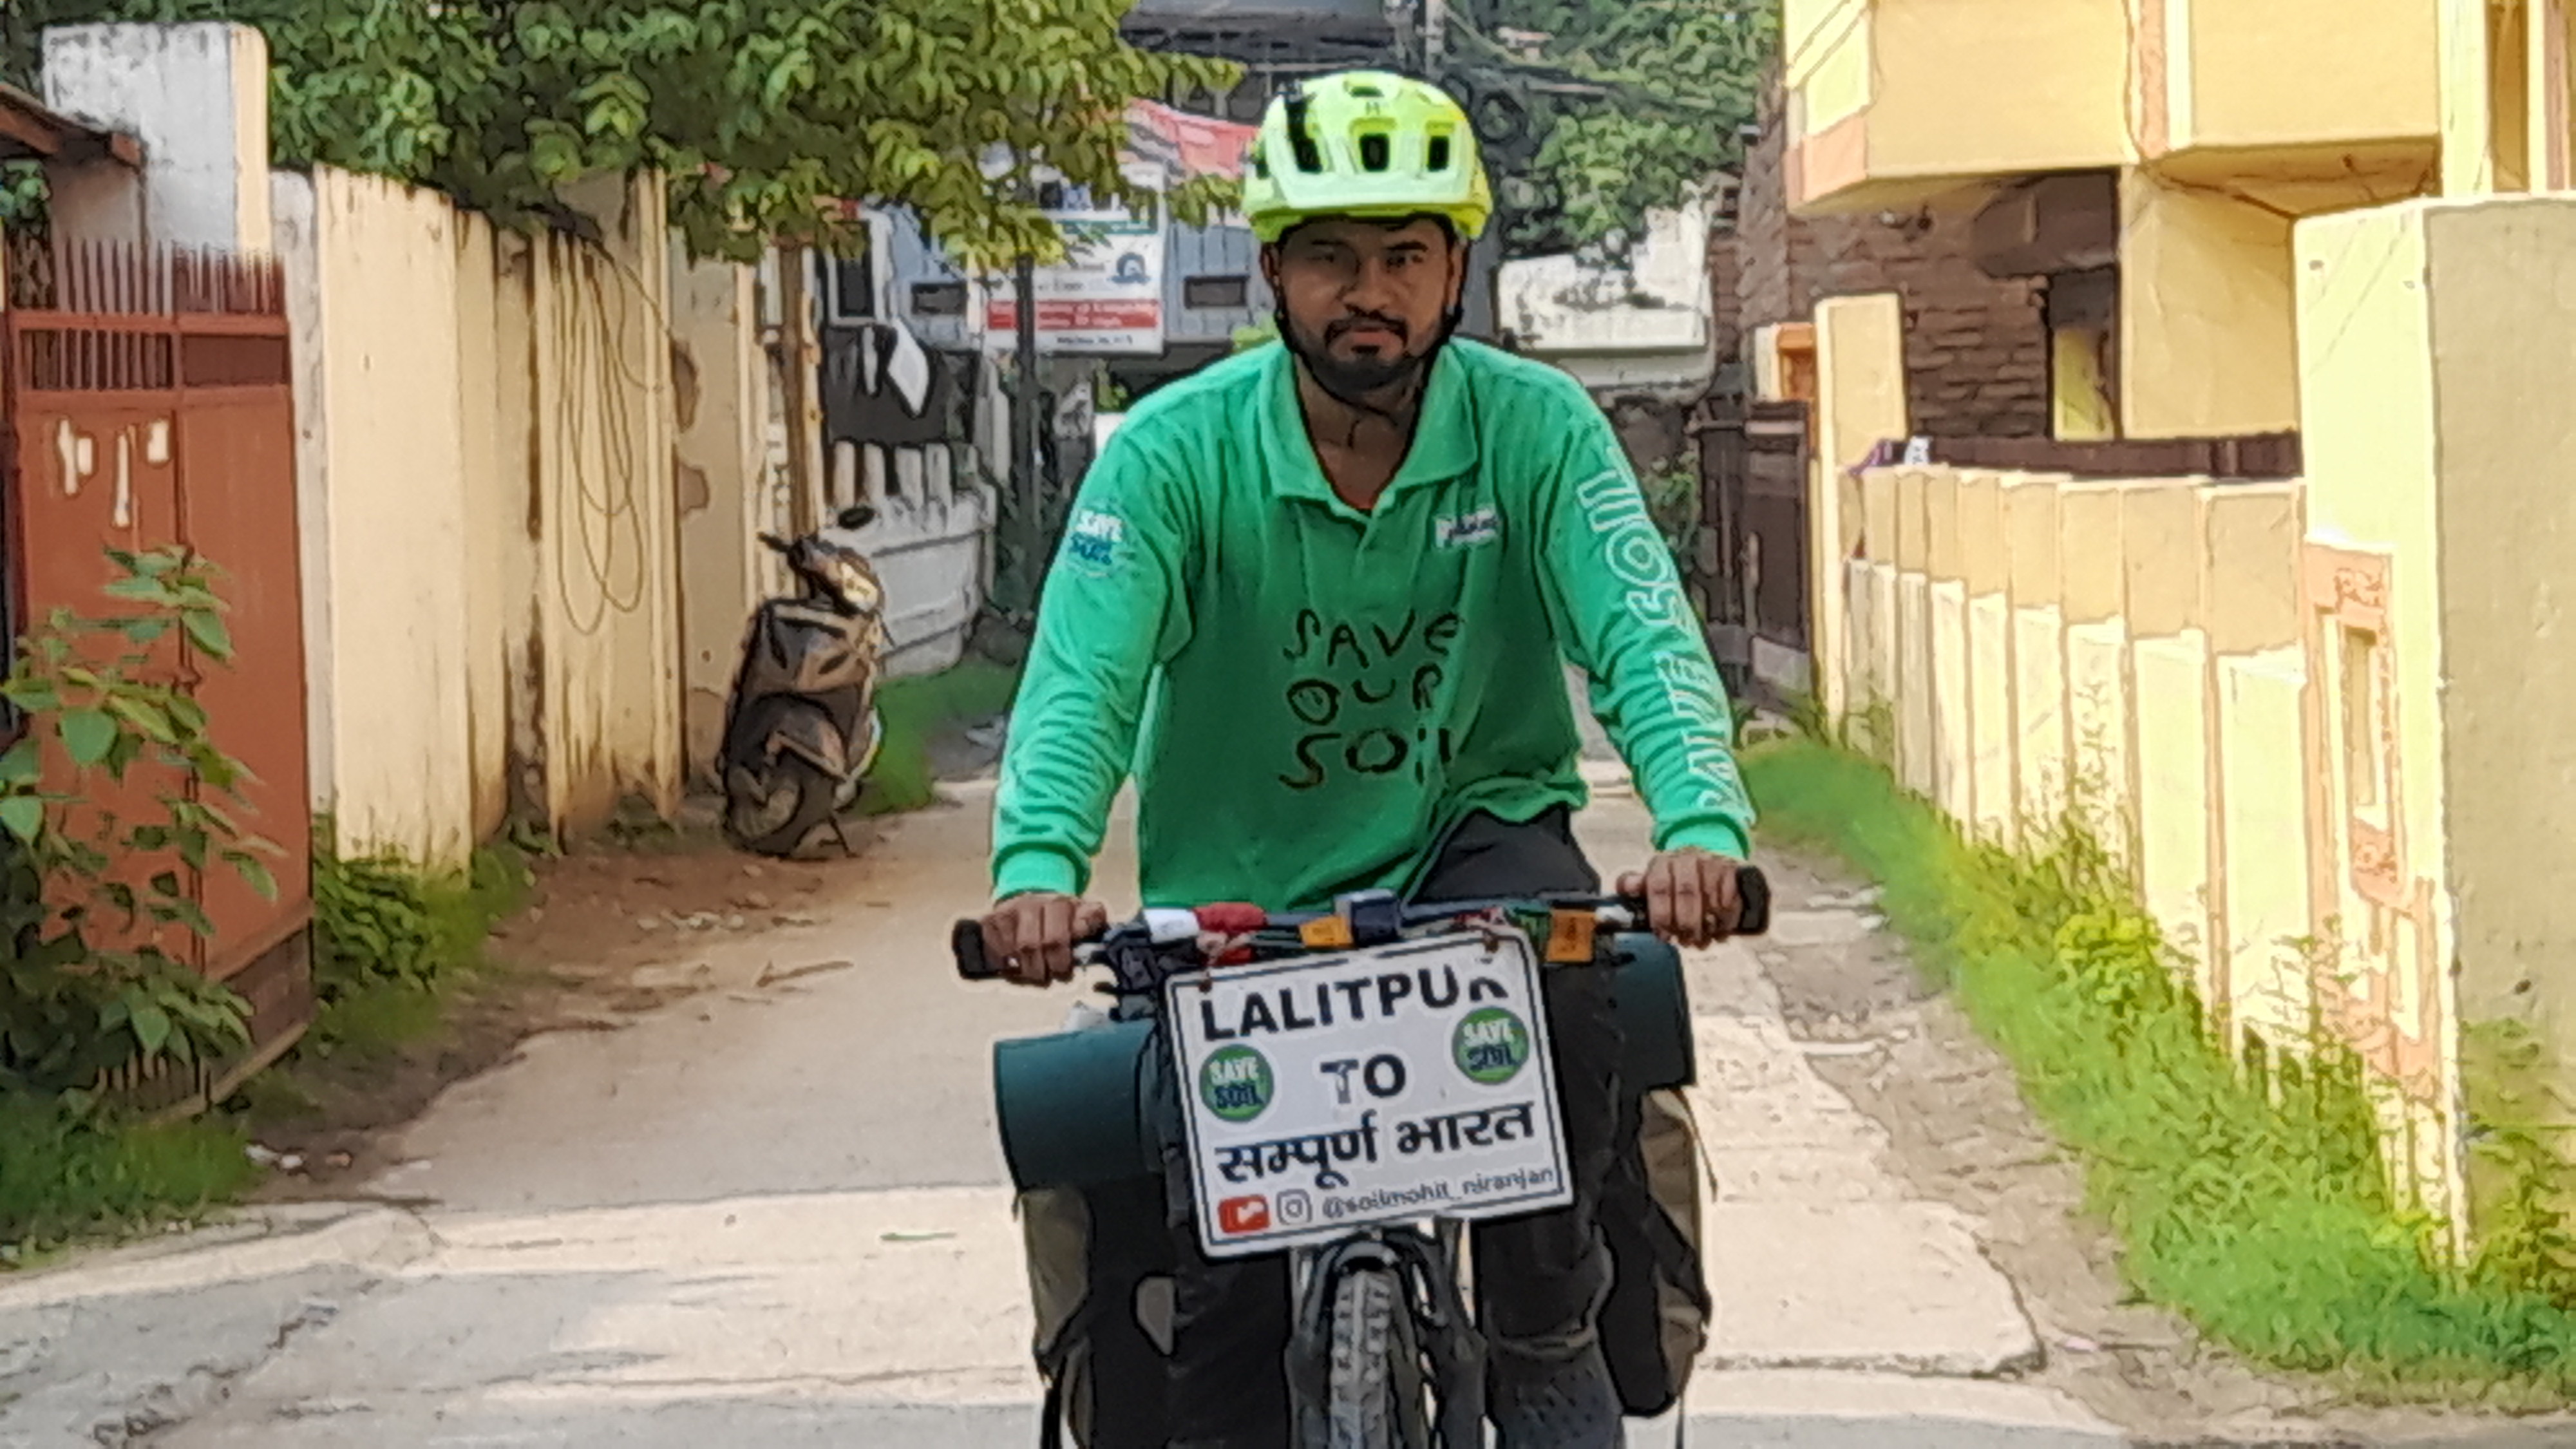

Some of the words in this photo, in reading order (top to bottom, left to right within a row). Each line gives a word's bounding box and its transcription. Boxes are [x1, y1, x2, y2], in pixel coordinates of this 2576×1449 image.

[1283, 609, 1460, 670] SAVE
[1287, 663, 1443, 726] OUR
[1463, 1017, 1515, 1047] SAVE
[1208, 1056, 1260, 1086] SAVE
[1320, 1054, 1406, 1104] TO
[1214, 1108, 1379, 1189] सम्पूर्ण
[1395, 1101, 1535, 1155] भारत
